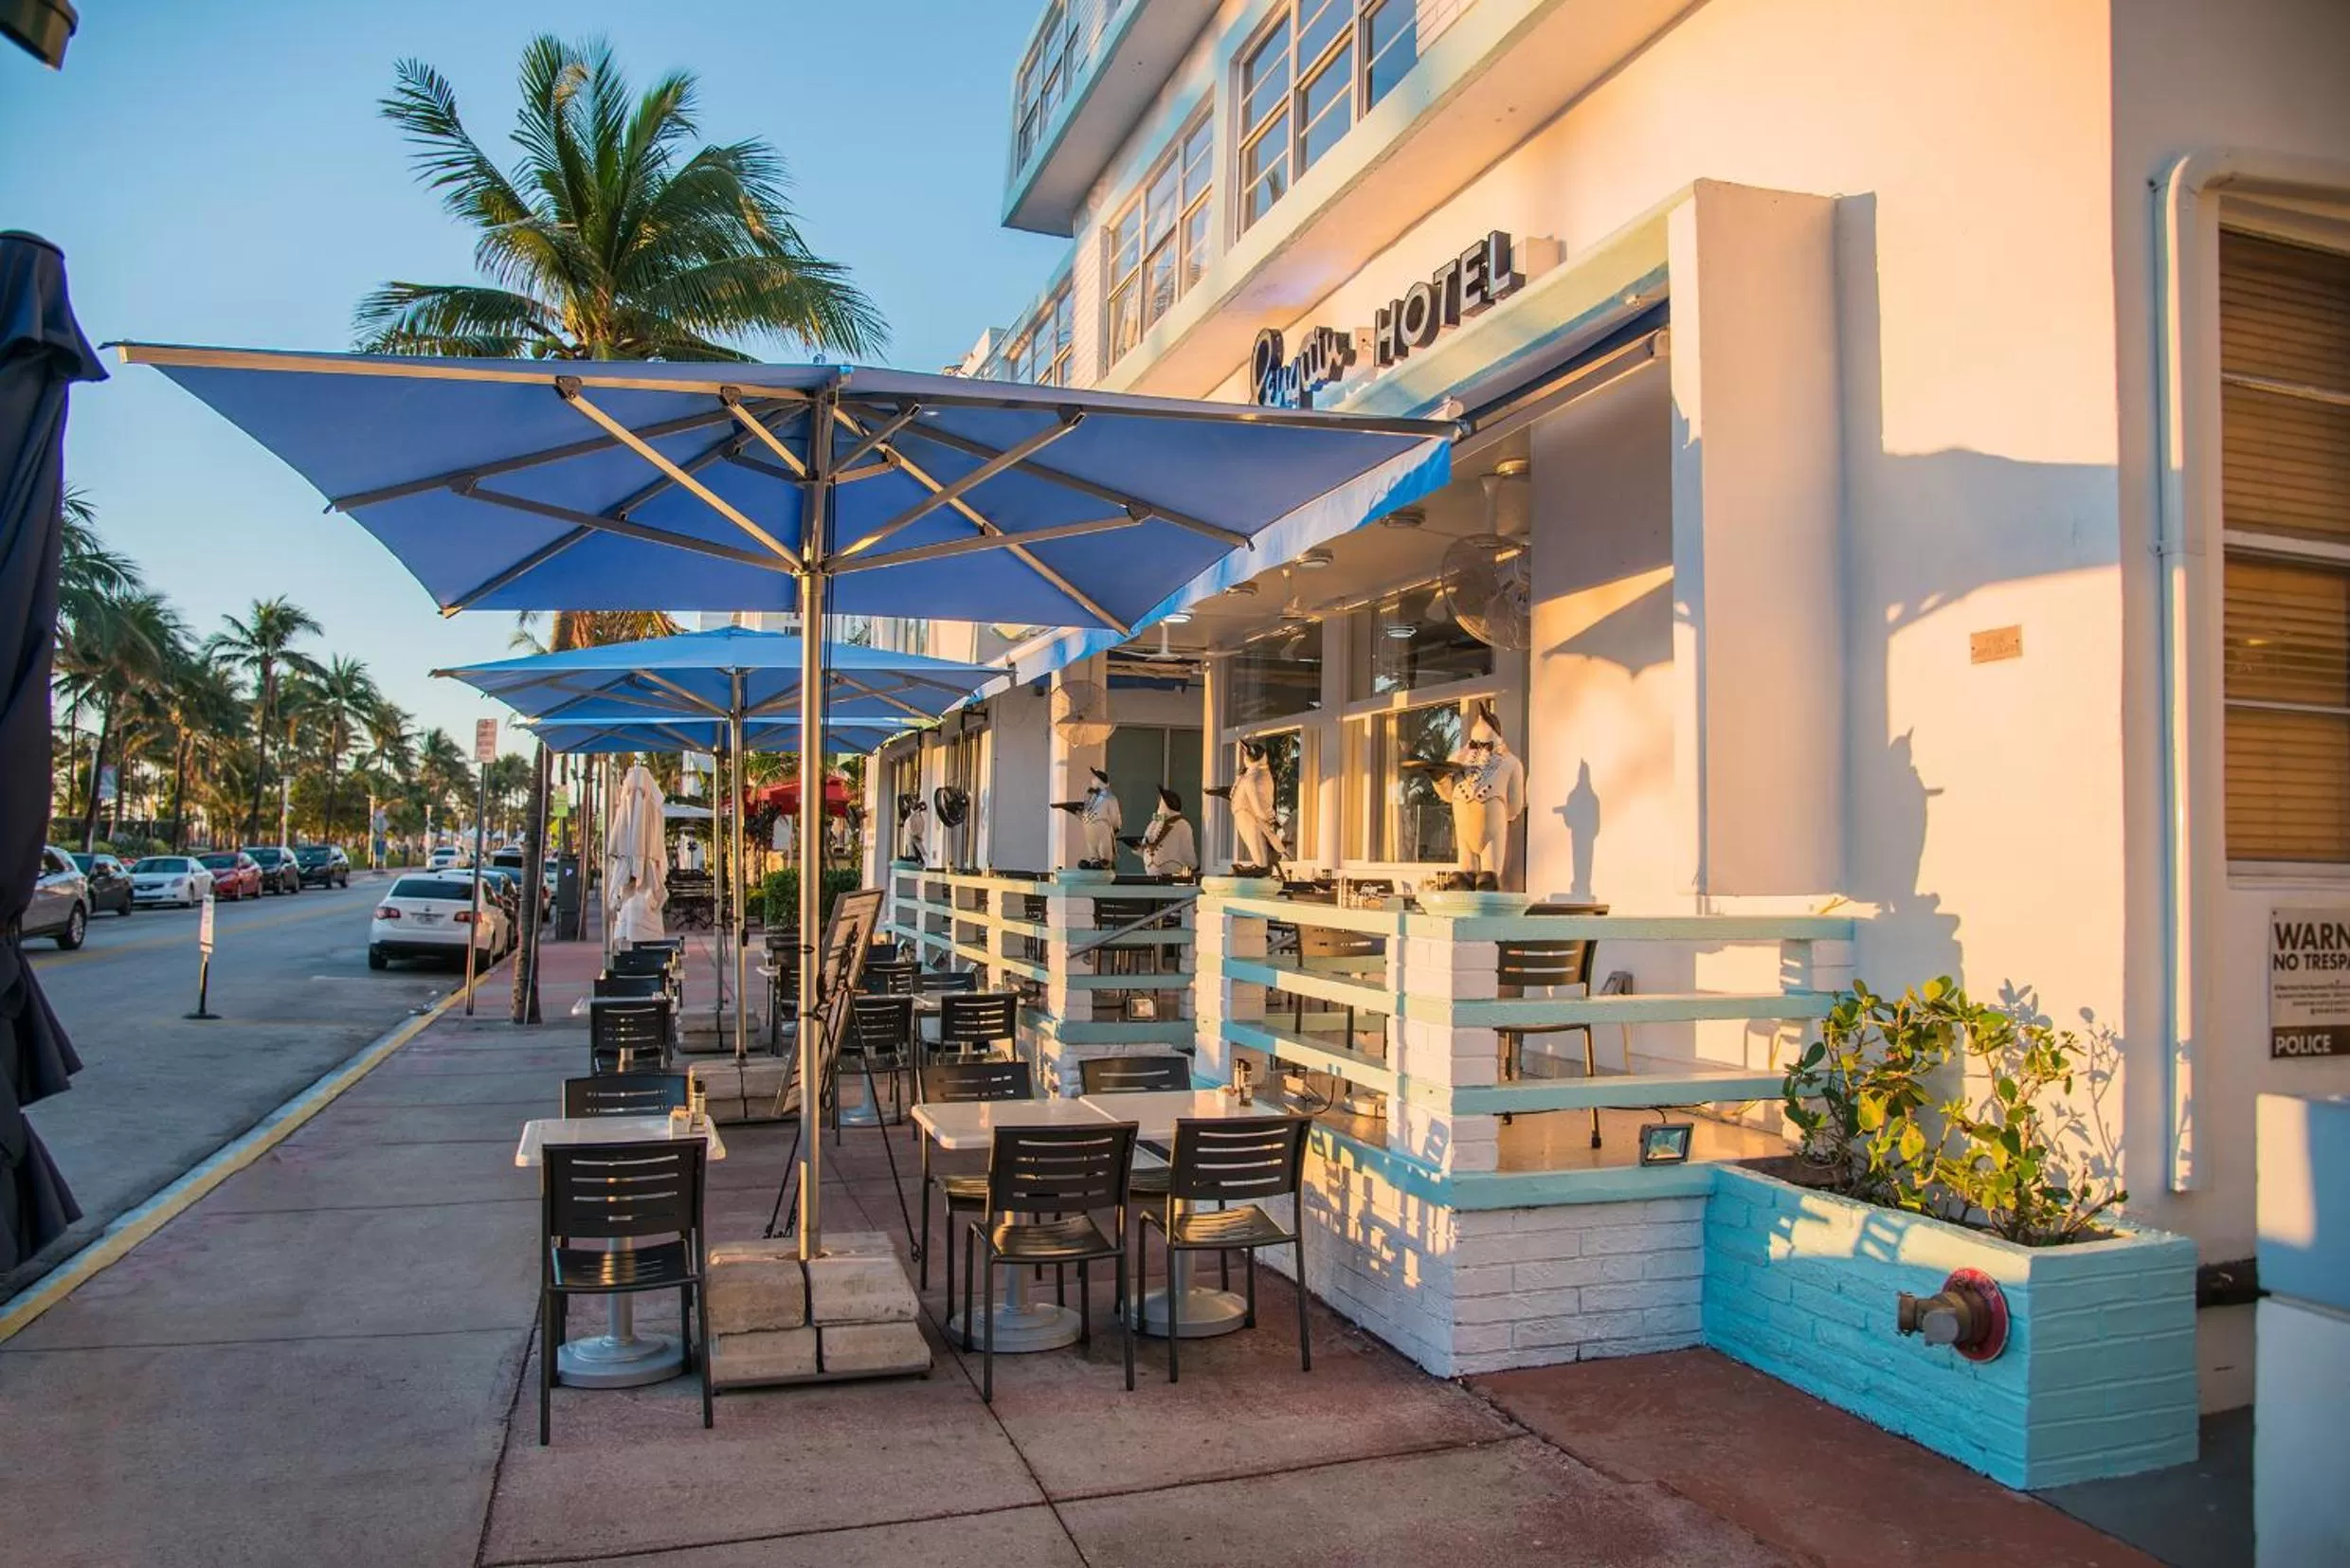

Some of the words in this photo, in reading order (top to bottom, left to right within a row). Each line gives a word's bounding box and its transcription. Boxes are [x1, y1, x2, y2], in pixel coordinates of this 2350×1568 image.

[1374, 229, 1526, 368] HOTEL
[2273, 953, 2299, 970] NO
[2276, 1034, 2331, 1054] POLICE
